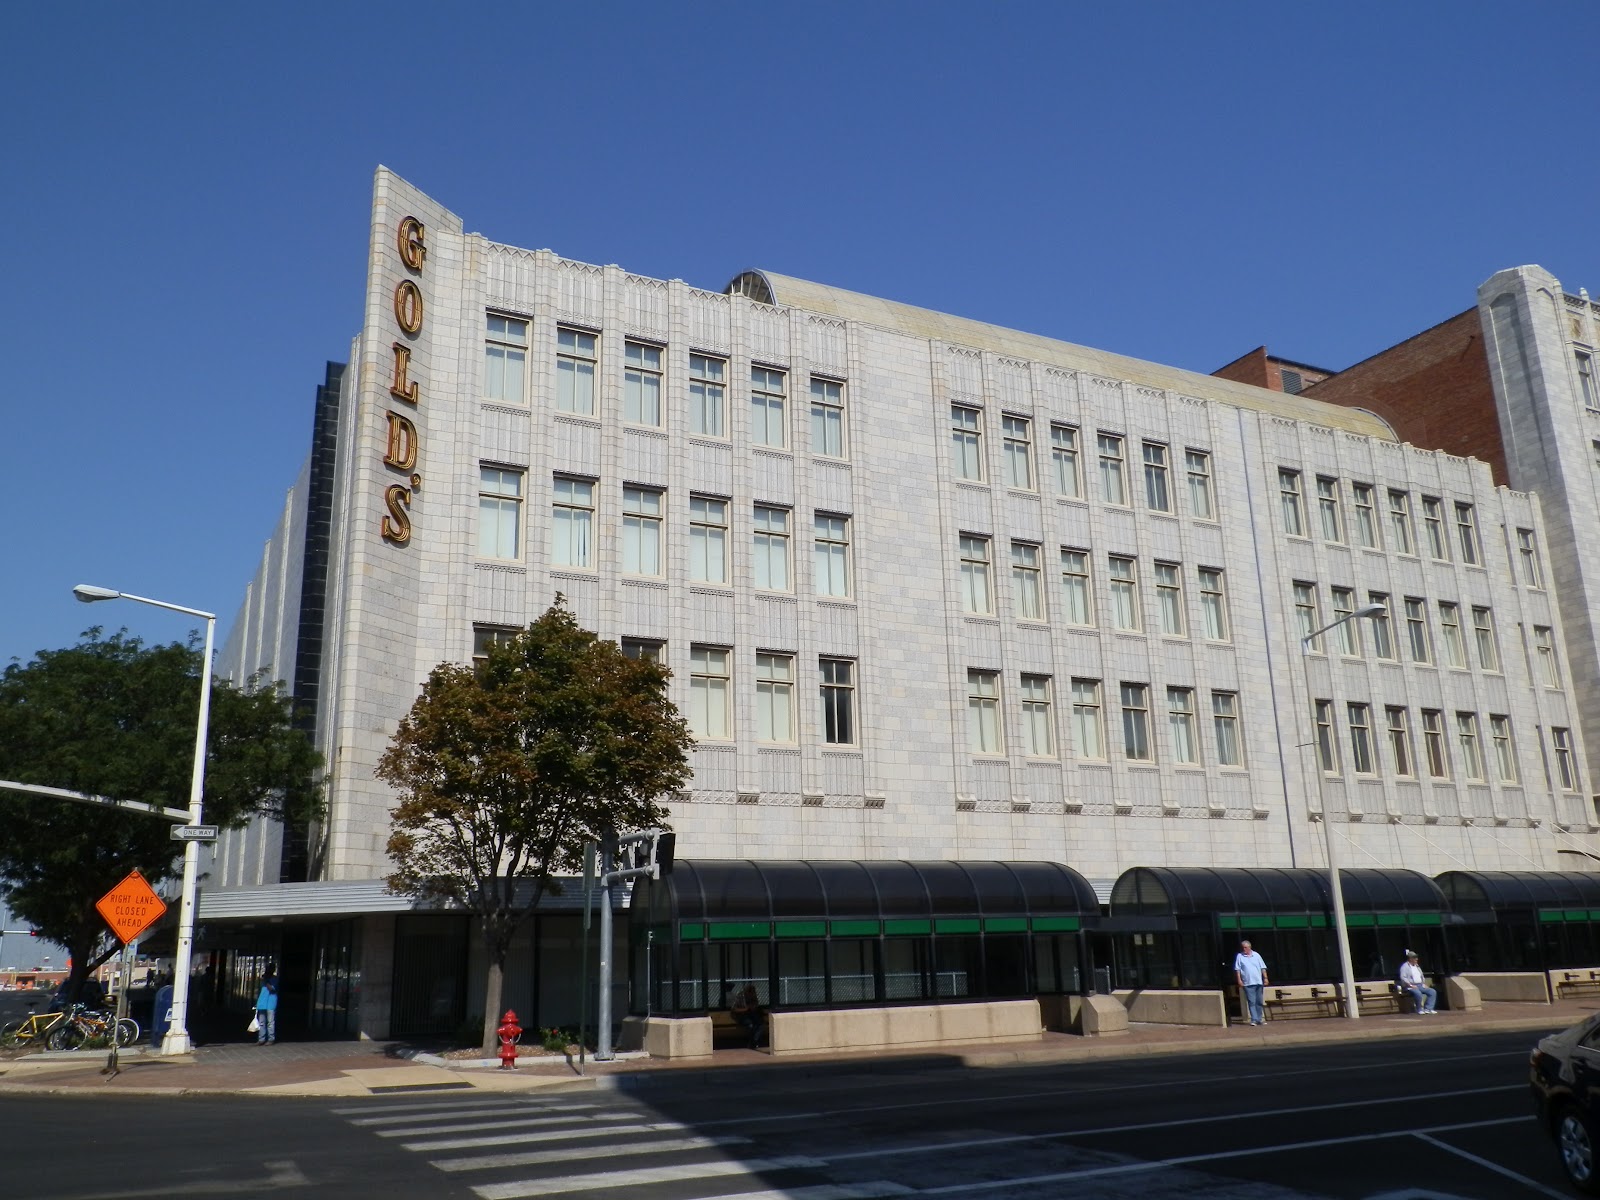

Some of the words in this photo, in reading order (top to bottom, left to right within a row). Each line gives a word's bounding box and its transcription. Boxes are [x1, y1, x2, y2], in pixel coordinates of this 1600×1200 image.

[110, 894, 131, 904] RIGHT
[135, 895, 154, 905] LANE
[115, 906, 146, 916] CLOSED
[116, 918, 142, 927] AHEAD
